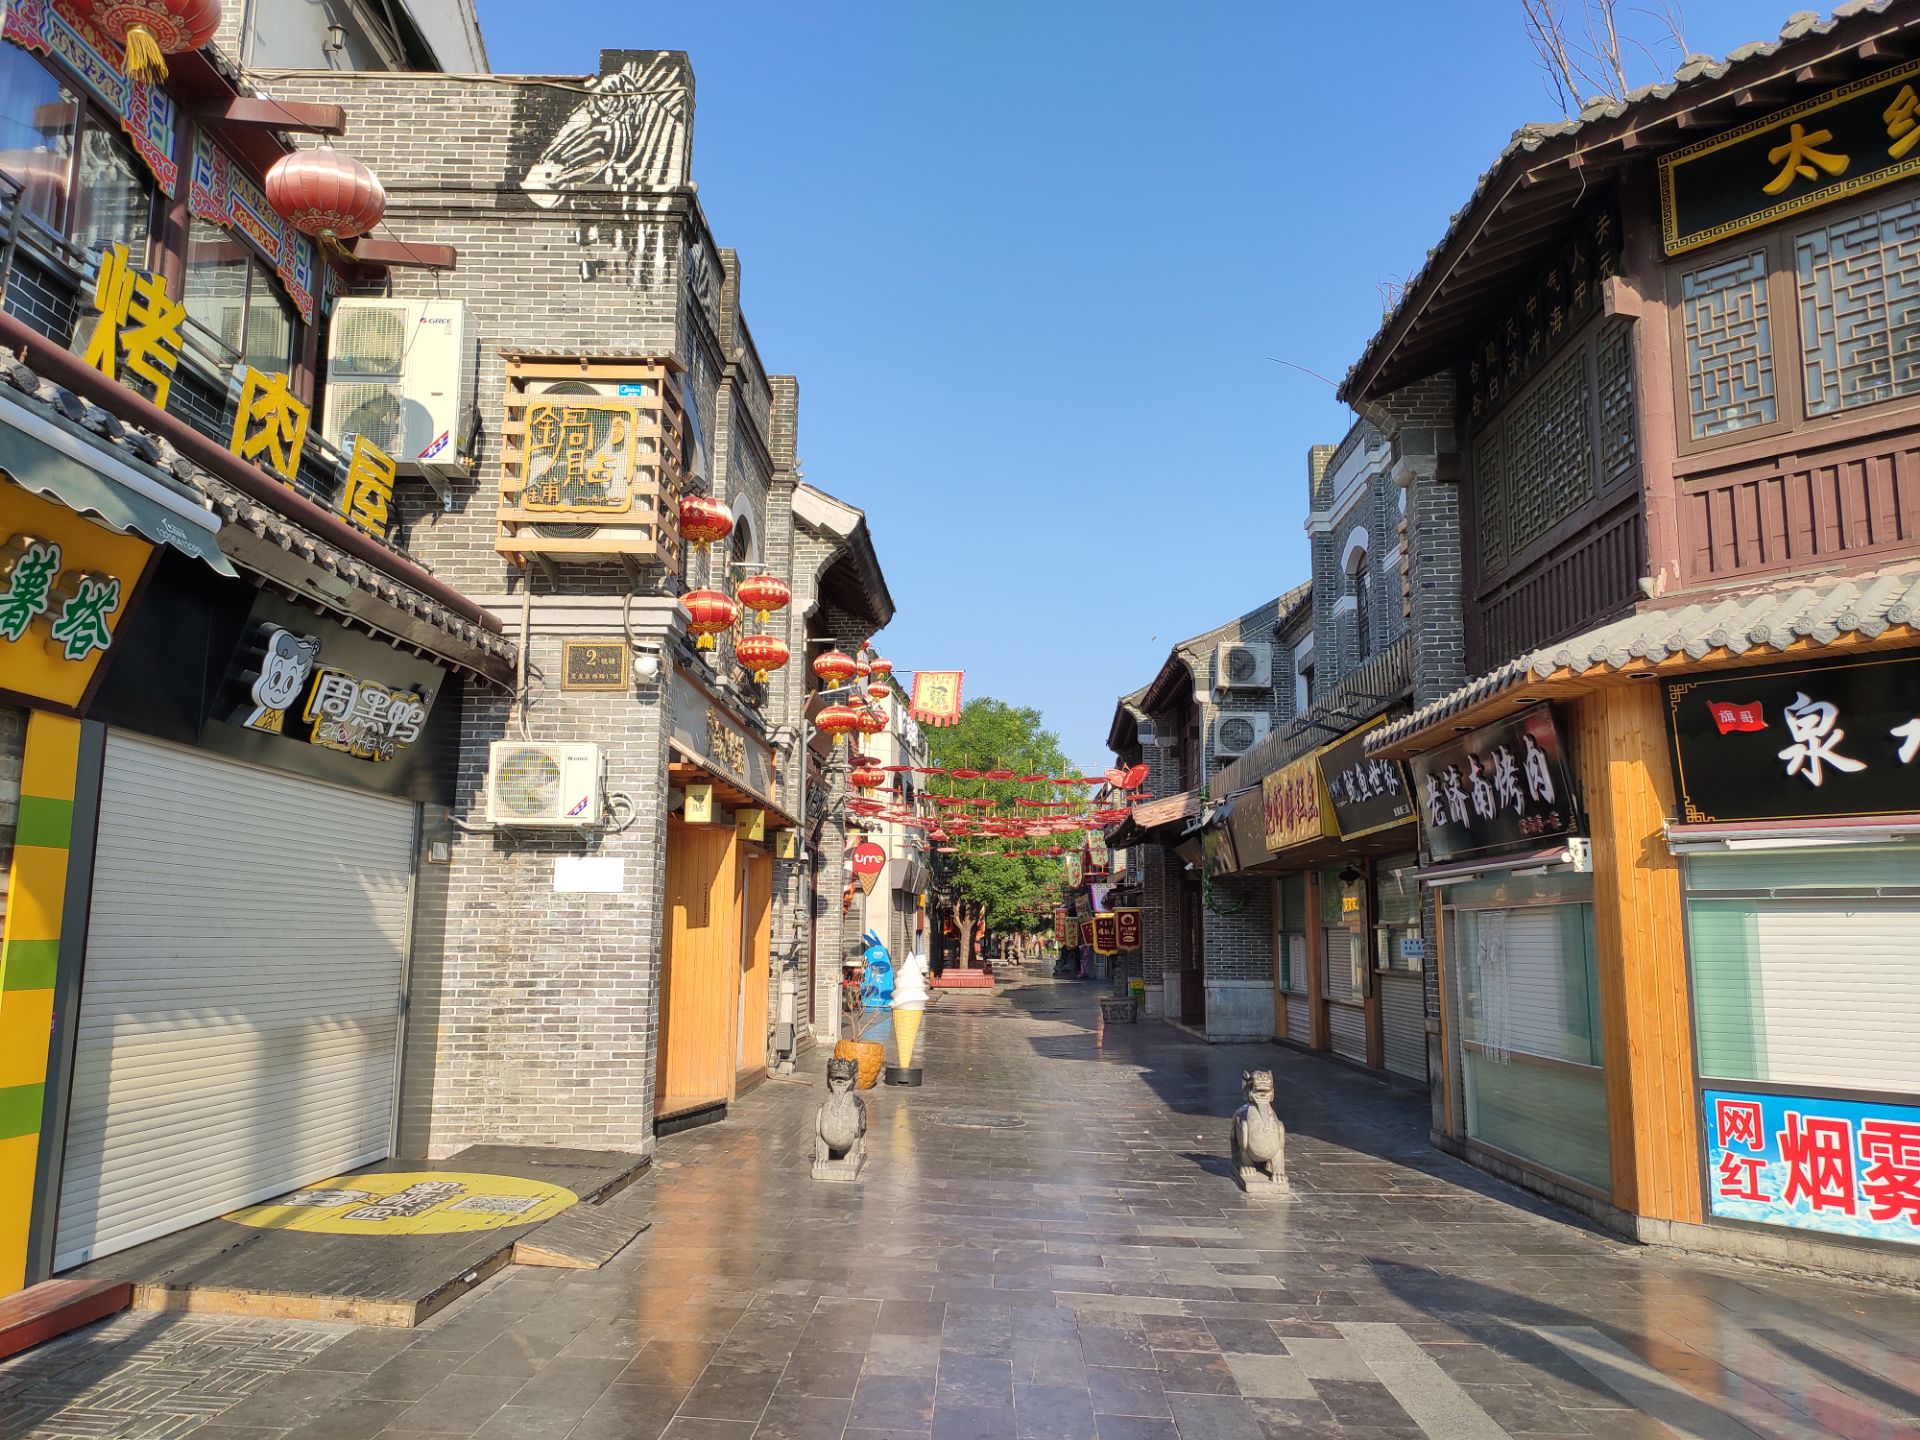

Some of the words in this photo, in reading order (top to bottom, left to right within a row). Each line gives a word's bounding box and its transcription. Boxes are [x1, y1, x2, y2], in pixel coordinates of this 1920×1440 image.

[83, 241, 397, 538] 烤肉屋
[310, 674, 425, 743] 周黑鸭
[1715, 1099, 1772, 1204] 网红
